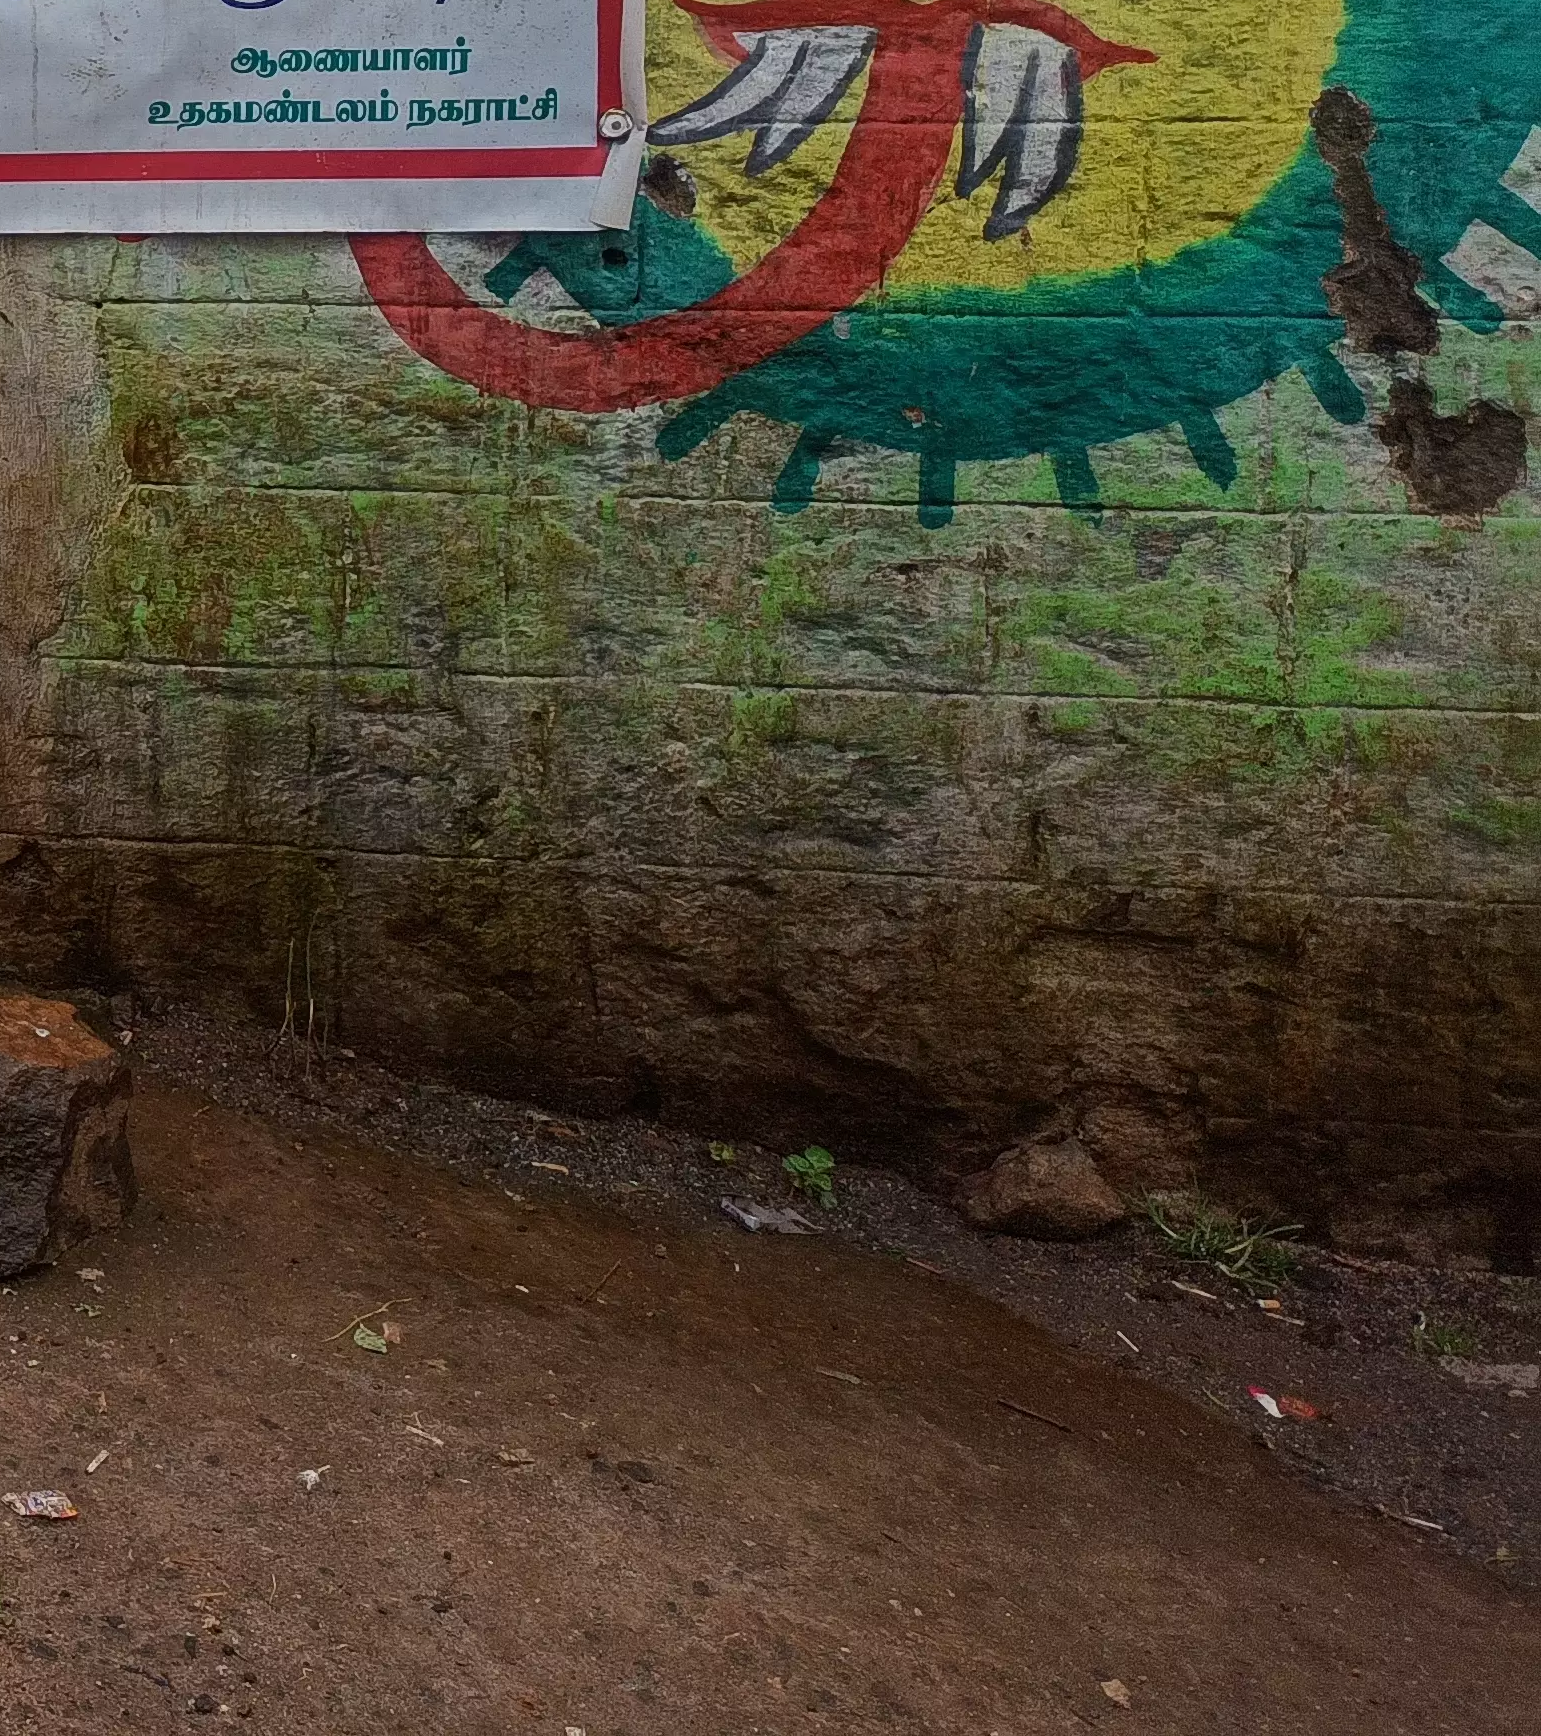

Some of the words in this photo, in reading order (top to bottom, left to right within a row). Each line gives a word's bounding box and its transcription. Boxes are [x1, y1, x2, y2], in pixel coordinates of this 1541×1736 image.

[230, 35, 473, 79] ஆணையாளர்
[148, 88, 399, 130] உதகமண்டலம்
[407, 87, 558, 128] நகராட்சி
